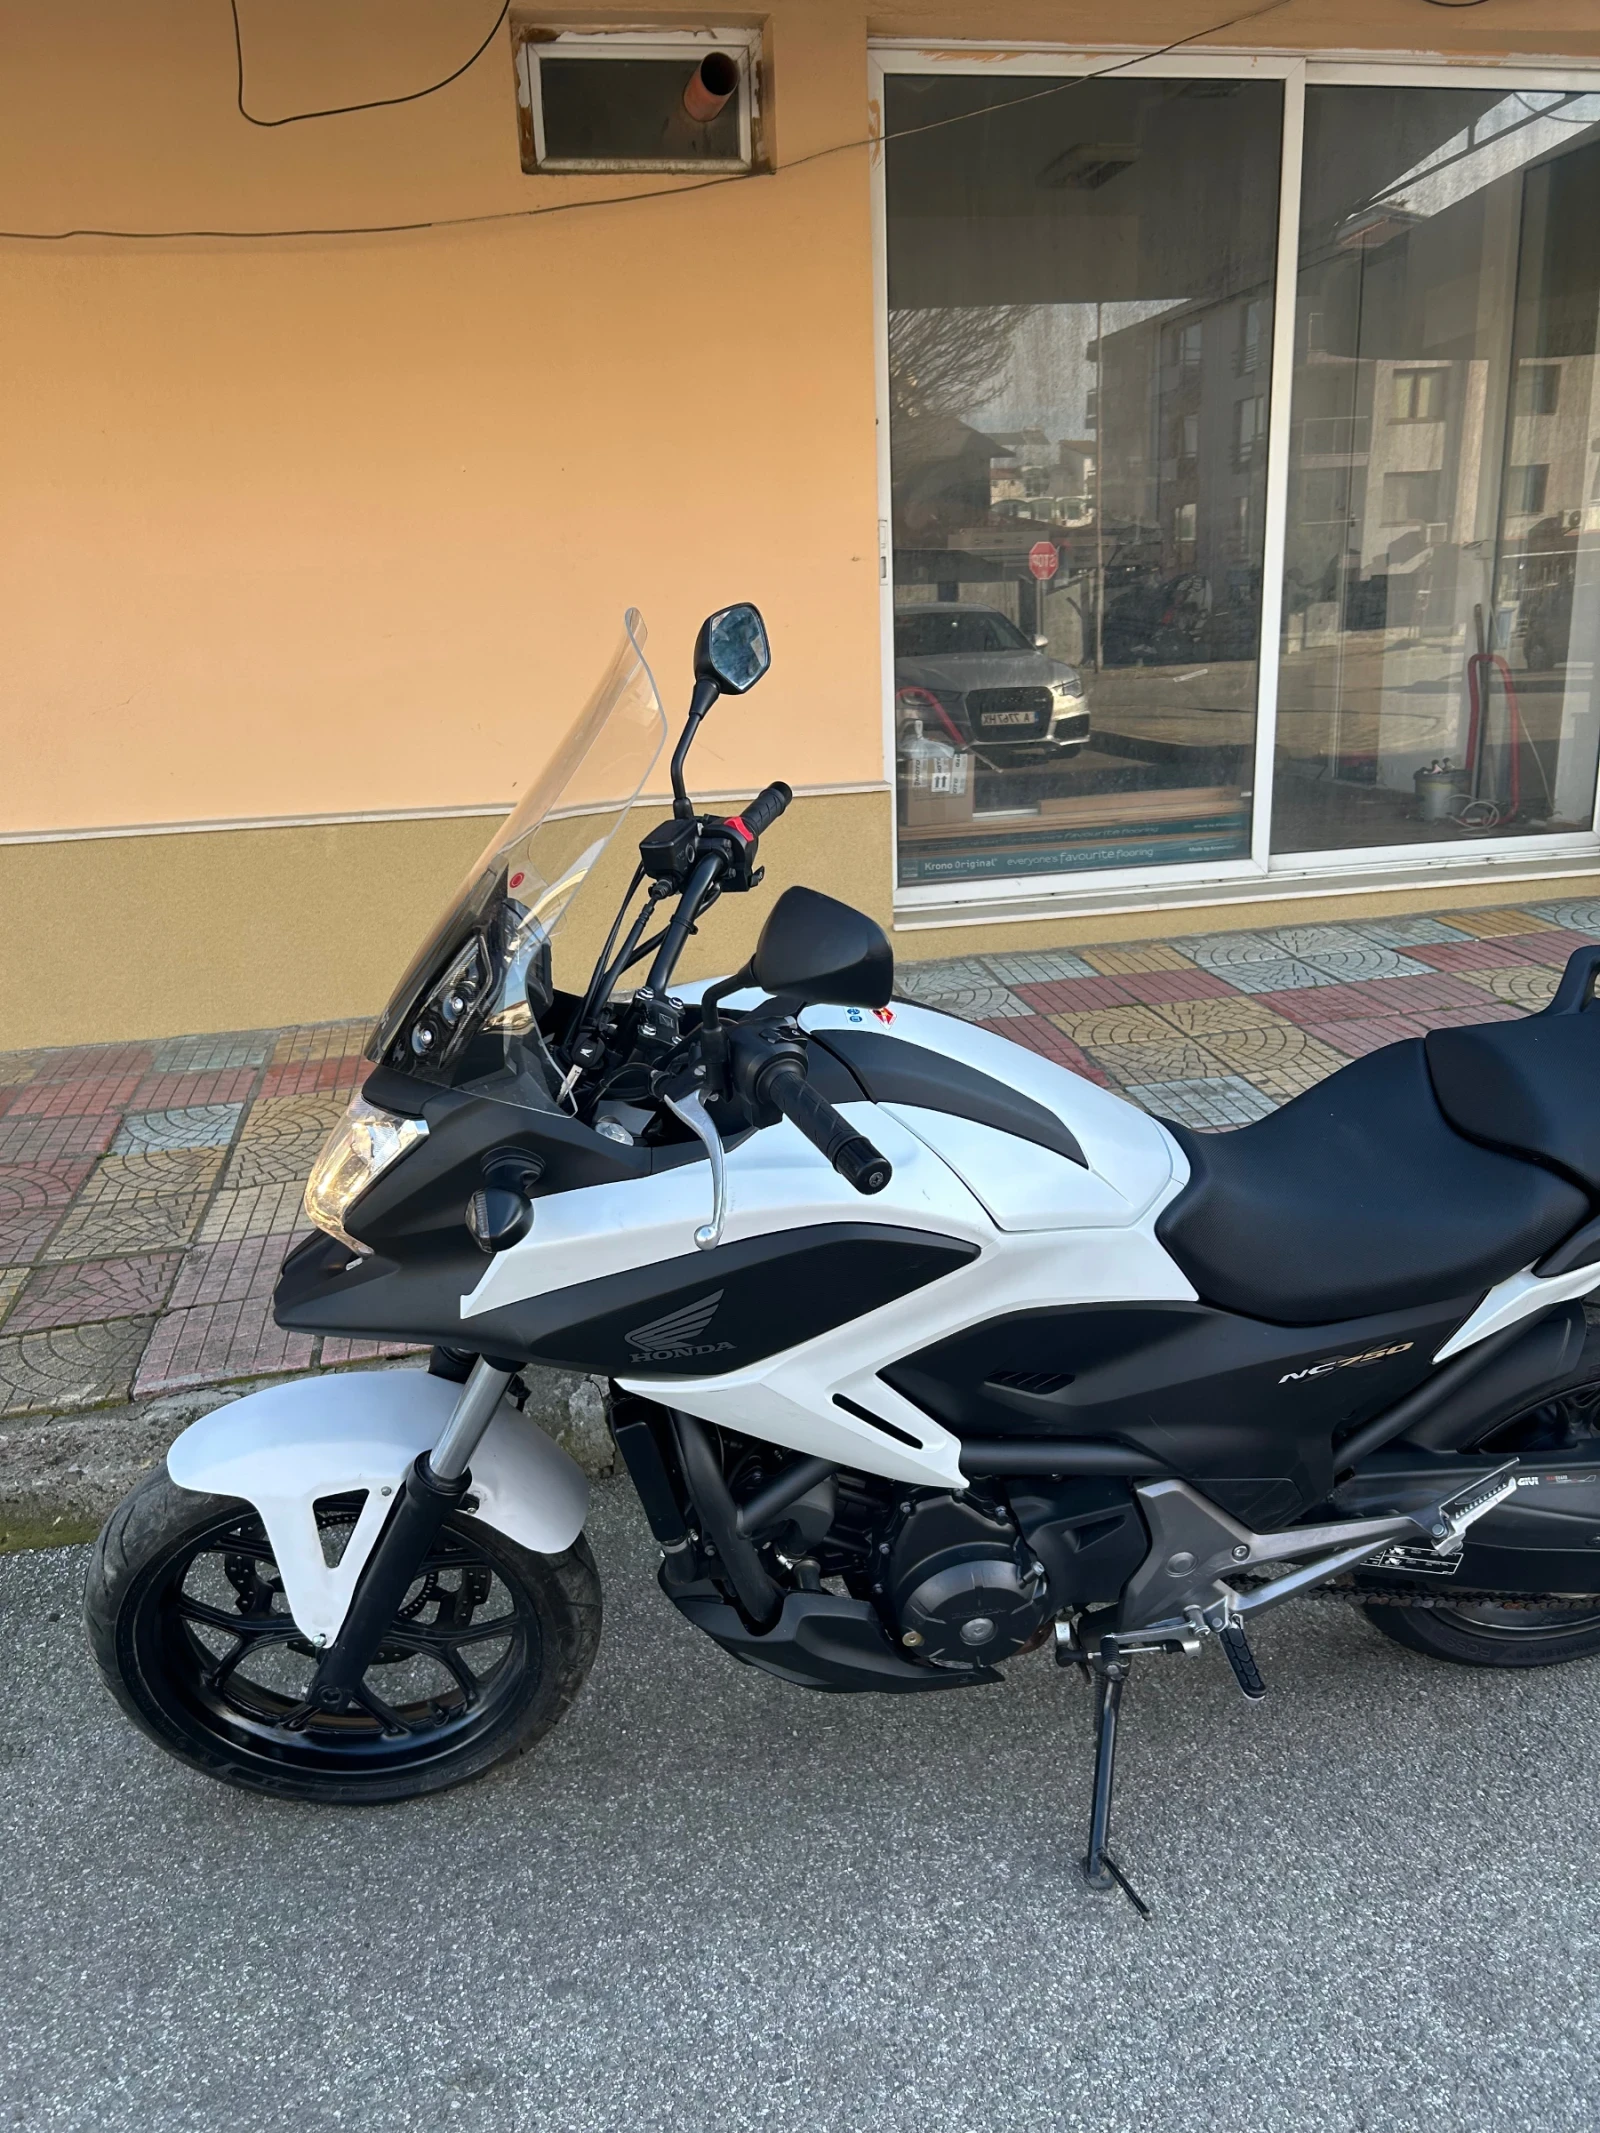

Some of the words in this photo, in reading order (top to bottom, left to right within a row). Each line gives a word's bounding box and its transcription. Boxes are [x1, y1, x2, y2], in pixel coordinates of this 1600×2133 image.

[1006, 855, 1058, 866] everyone's
[1060, 850, 1115, 864] favourite
[1115, 848, 1154, 860] flooring
[924, 862, 953, 871] Krono
[629, 1341, 738, 1363] HONDA
